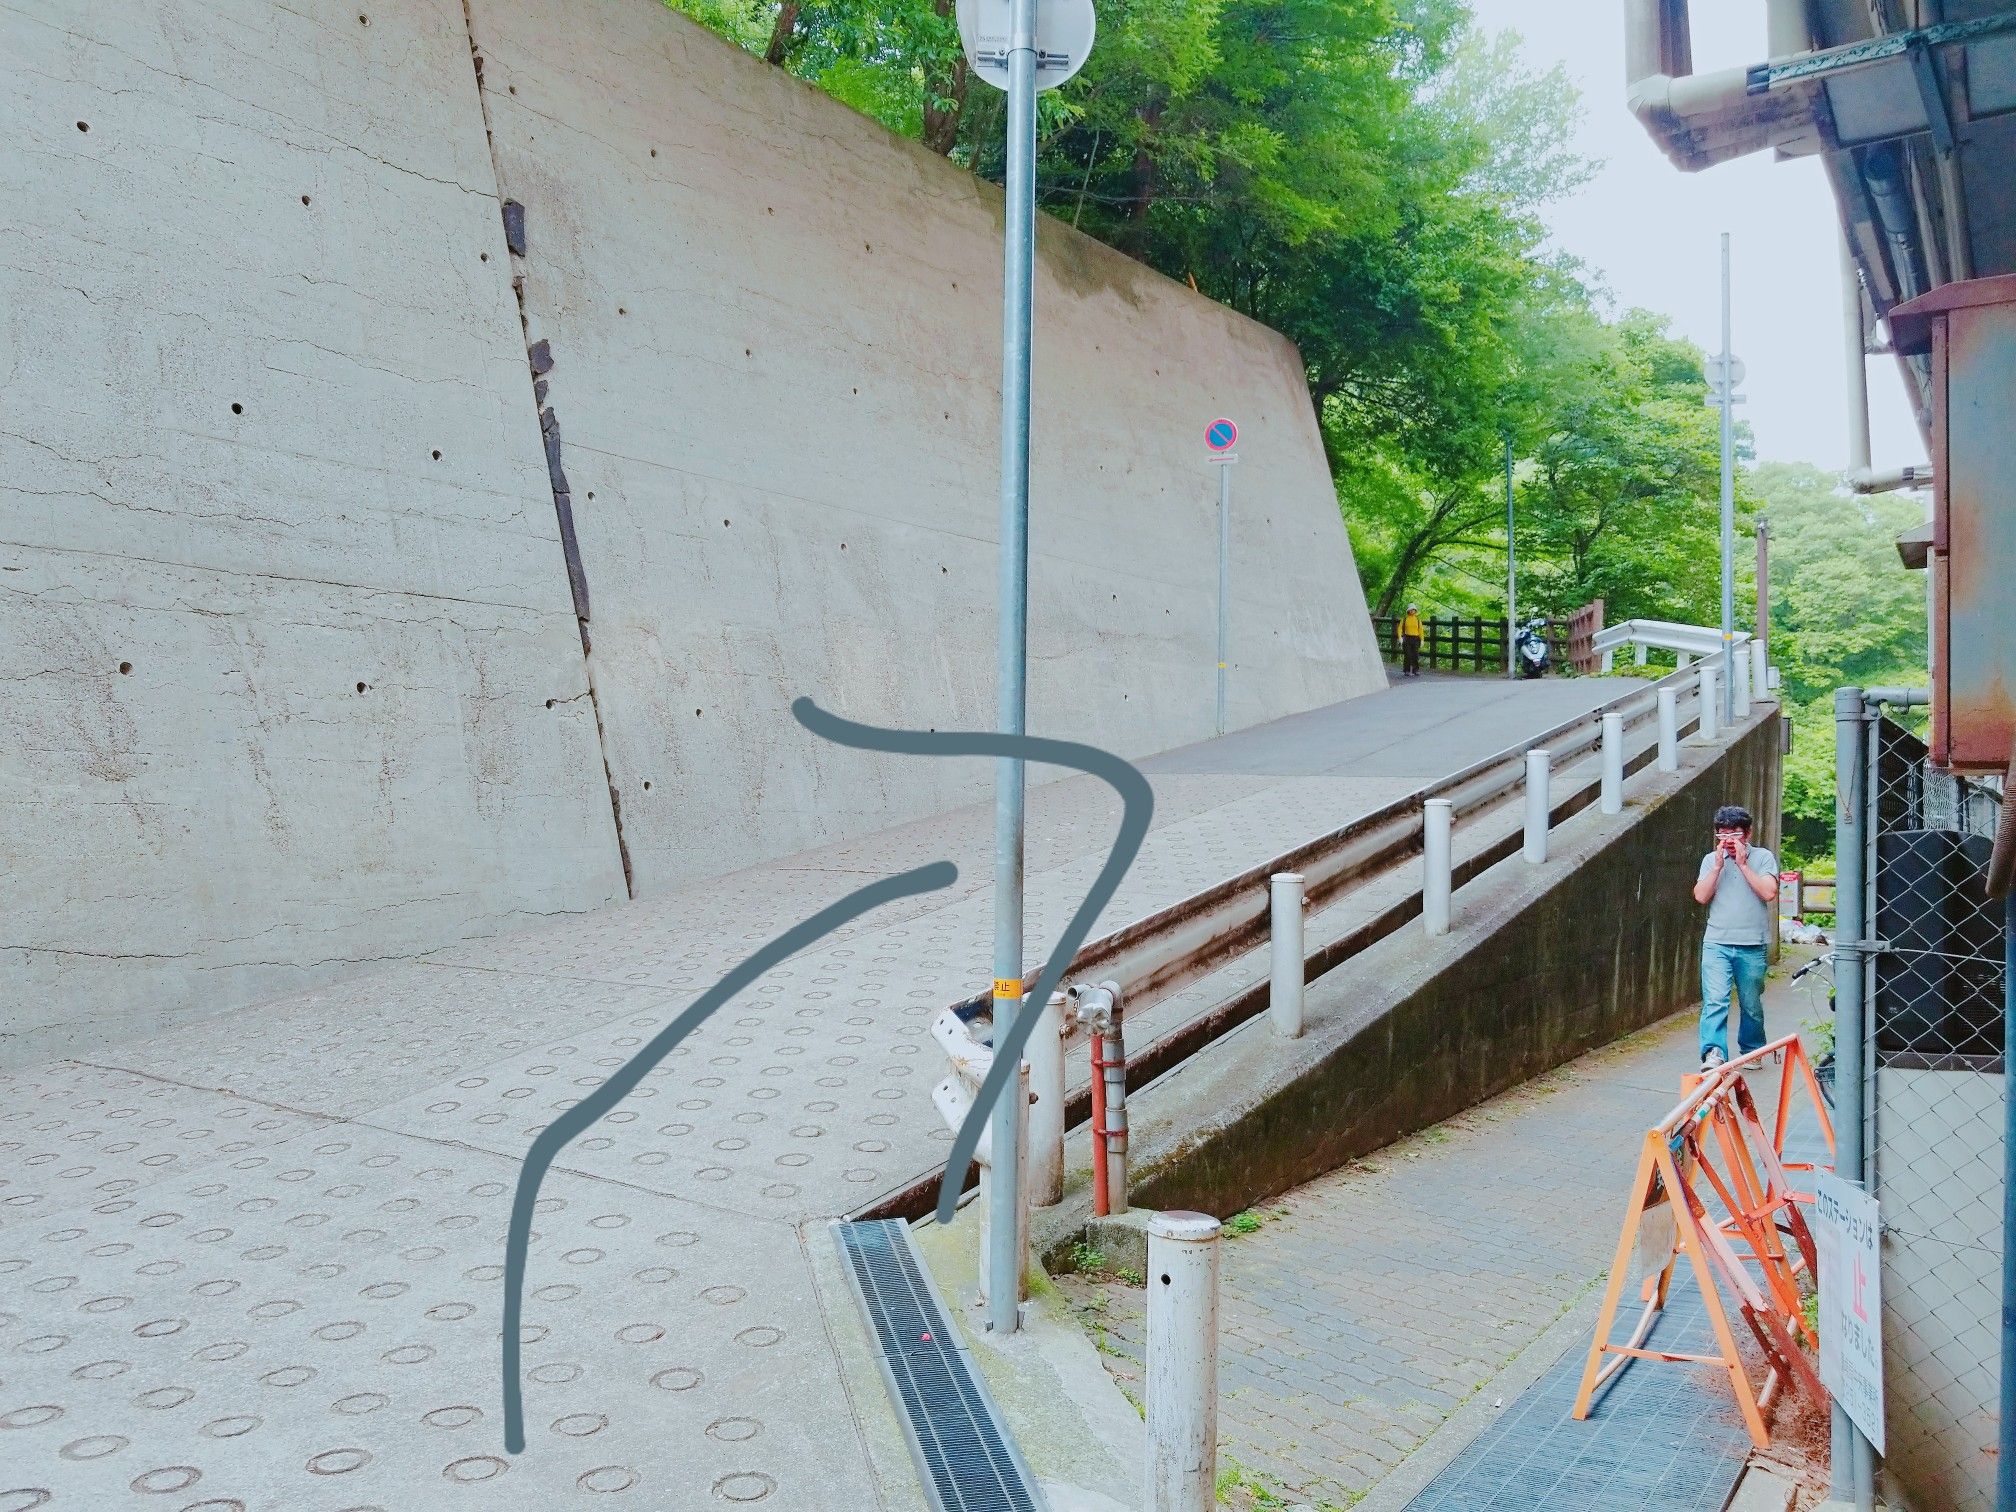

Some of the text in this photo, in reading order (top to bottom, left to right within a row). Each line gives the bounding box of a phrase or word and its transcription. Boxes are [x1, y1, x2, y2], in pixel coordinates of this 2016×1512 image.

[1817, 1189, 1873, 1250] このステーションは
